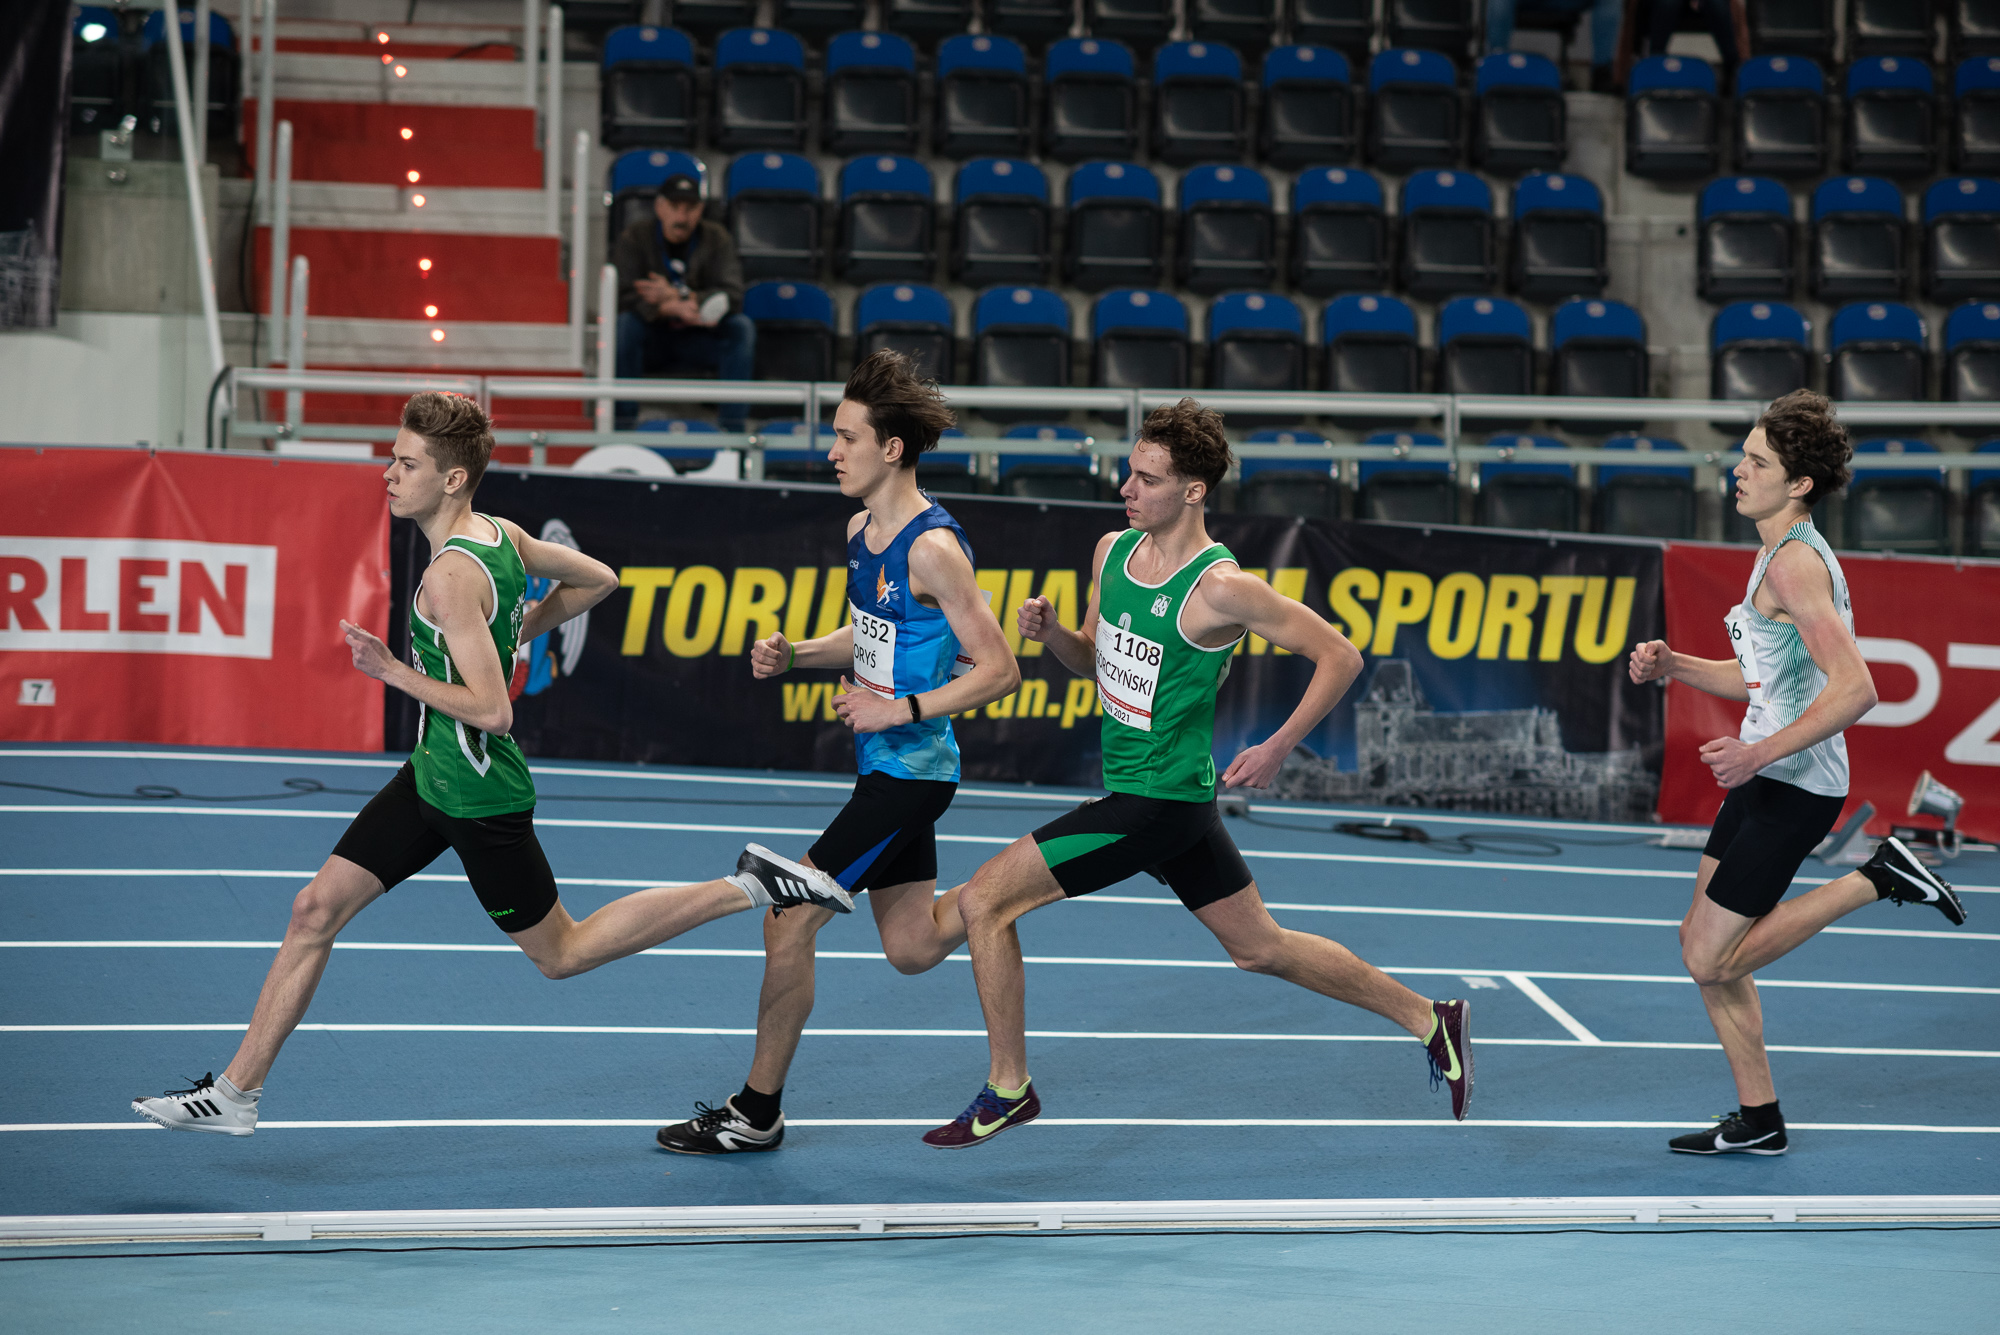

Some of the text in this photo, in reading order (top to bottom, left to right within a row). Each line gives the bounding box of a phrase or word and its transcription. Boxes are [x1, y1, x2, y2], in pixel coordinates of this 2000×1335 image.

[0, 556, 247, 637] RLEN
[861, 615, 889, 643] 552
[1328, 566, 1636, 664] SPORTU
[1113, 632, 1161, 667] 1108
[31, 682, 44, 703] 7
[1114, 707, 1130, 723] 2021
